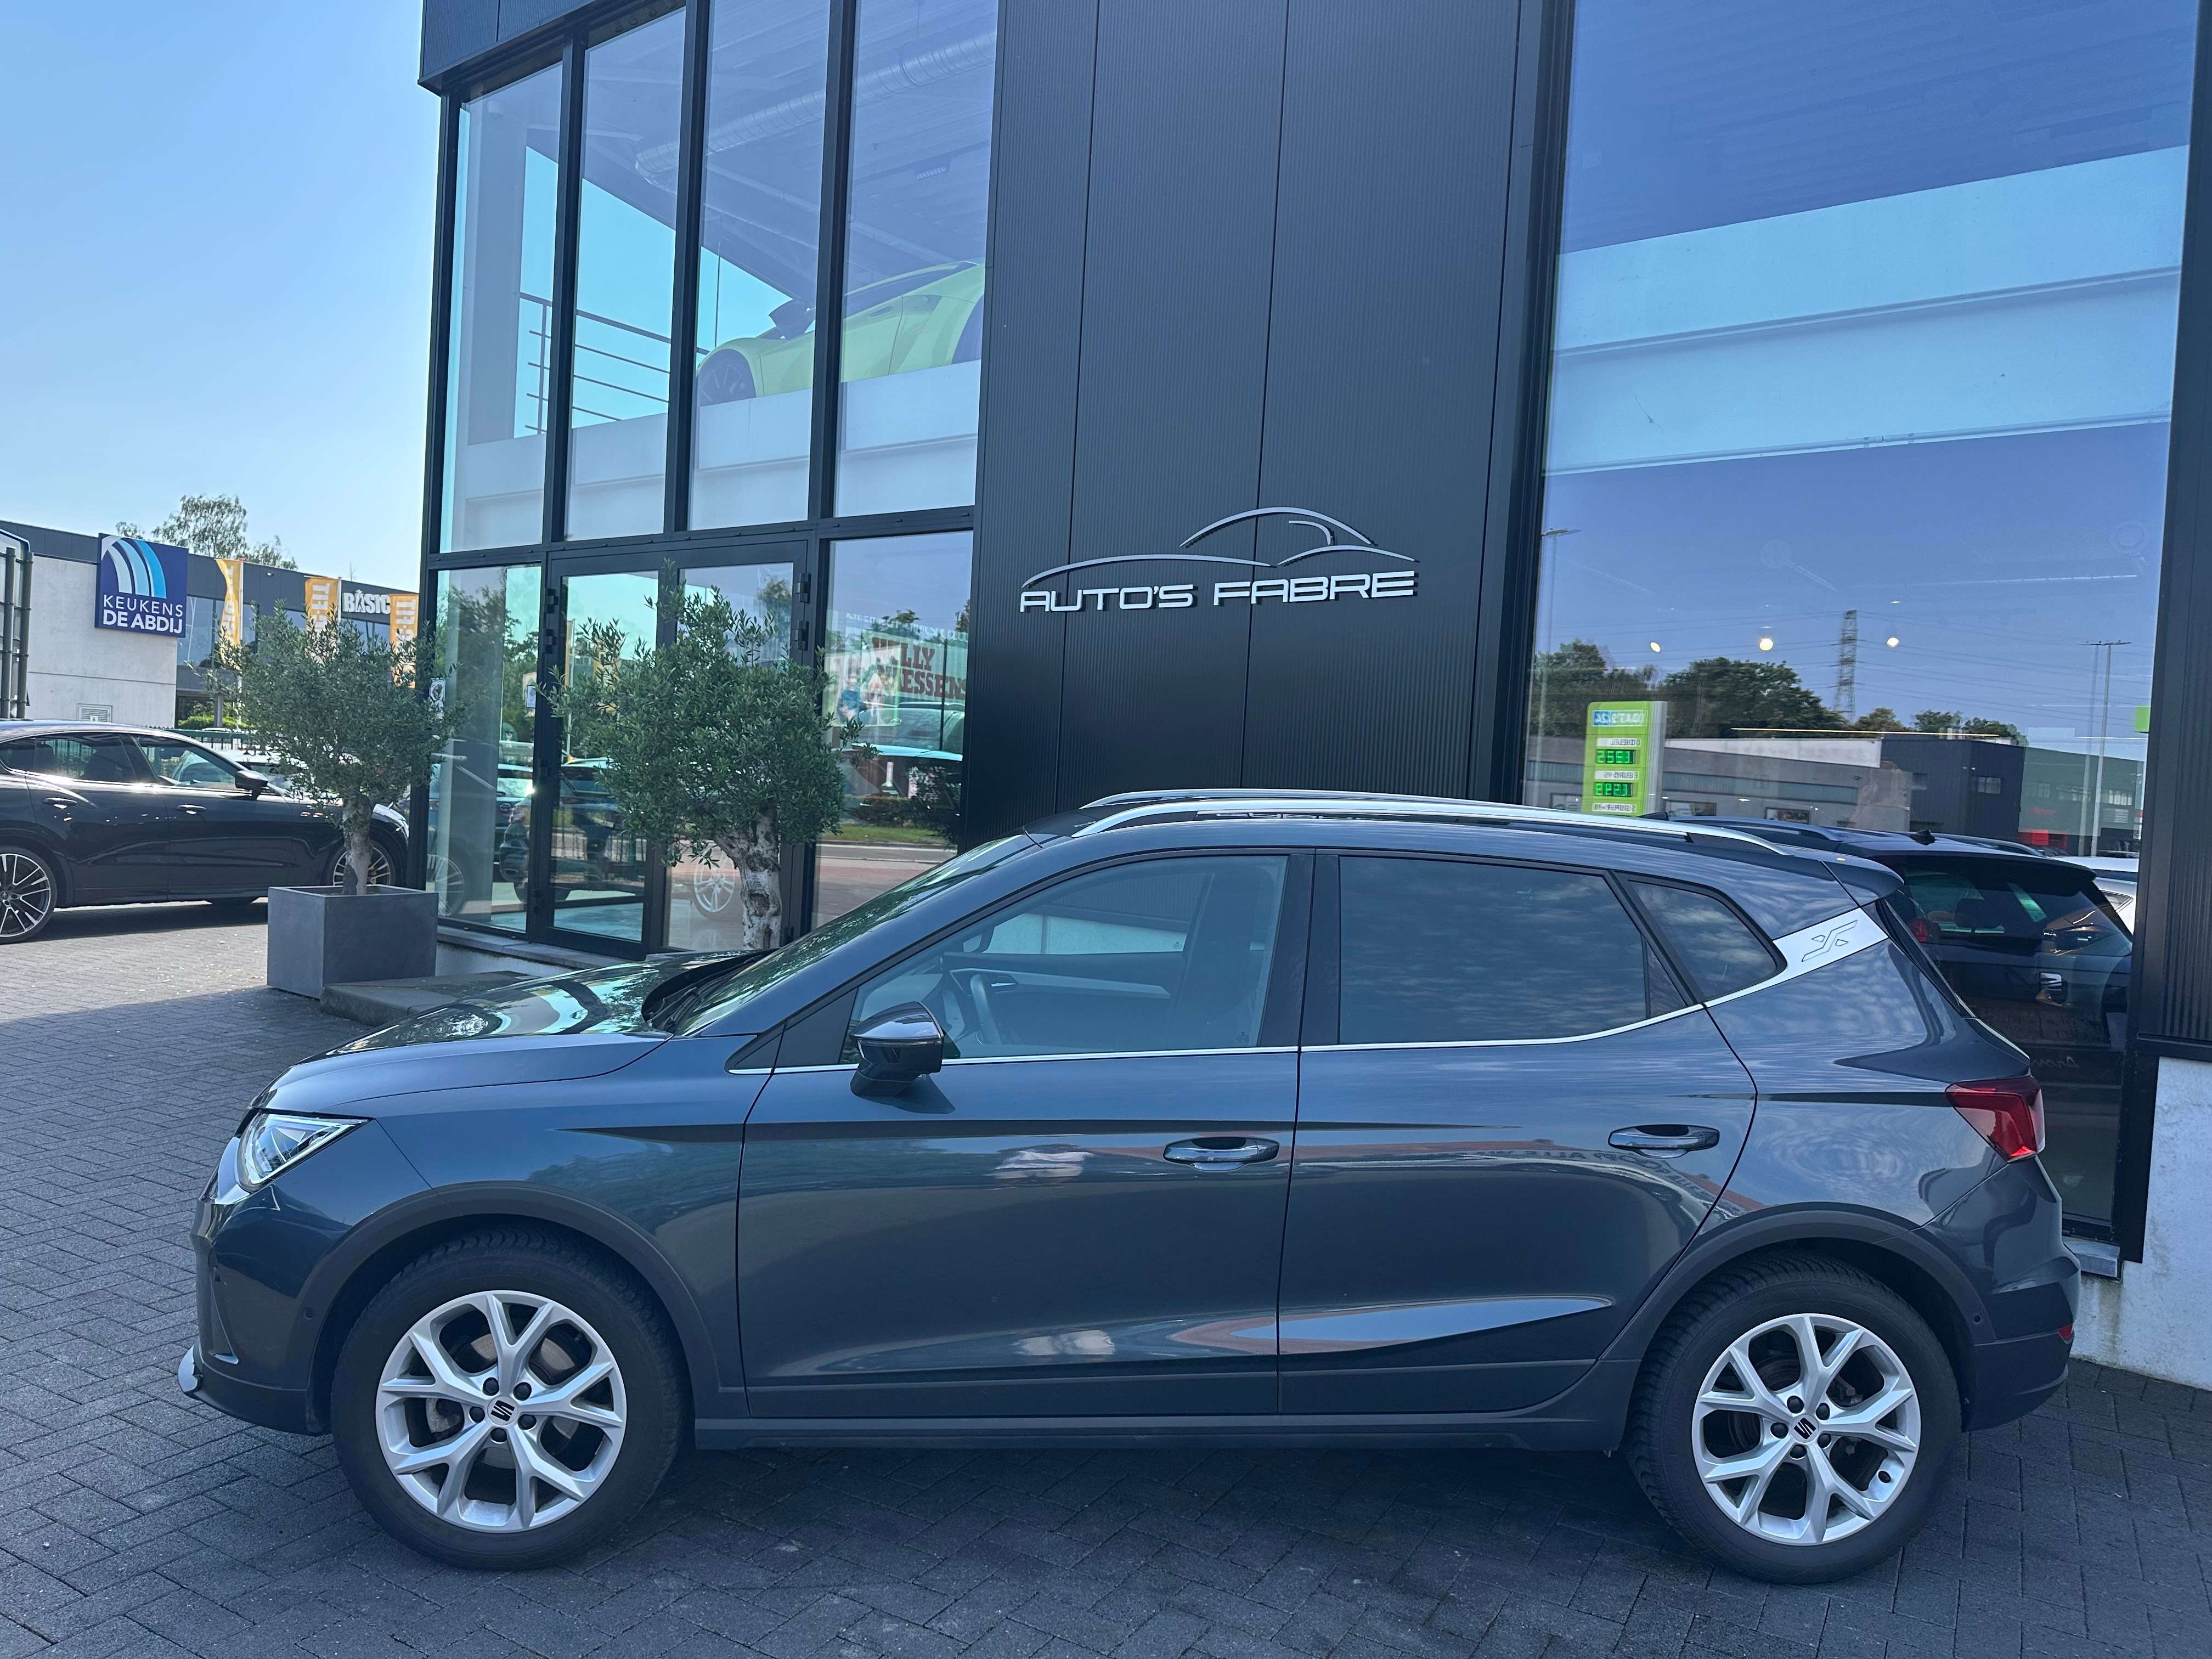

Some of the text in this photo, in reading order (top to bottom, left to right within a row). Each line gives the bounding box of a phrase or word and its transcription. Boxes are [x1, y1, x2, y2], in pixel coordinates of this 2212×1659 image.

[342, 590, 391, 614] BASIC
[1020, 571, 1415, 612] AUTO'S FABRE
[103, 594, 183, 617] KEUKENS
[103, 609, 183, 634] DE ABDIJ
